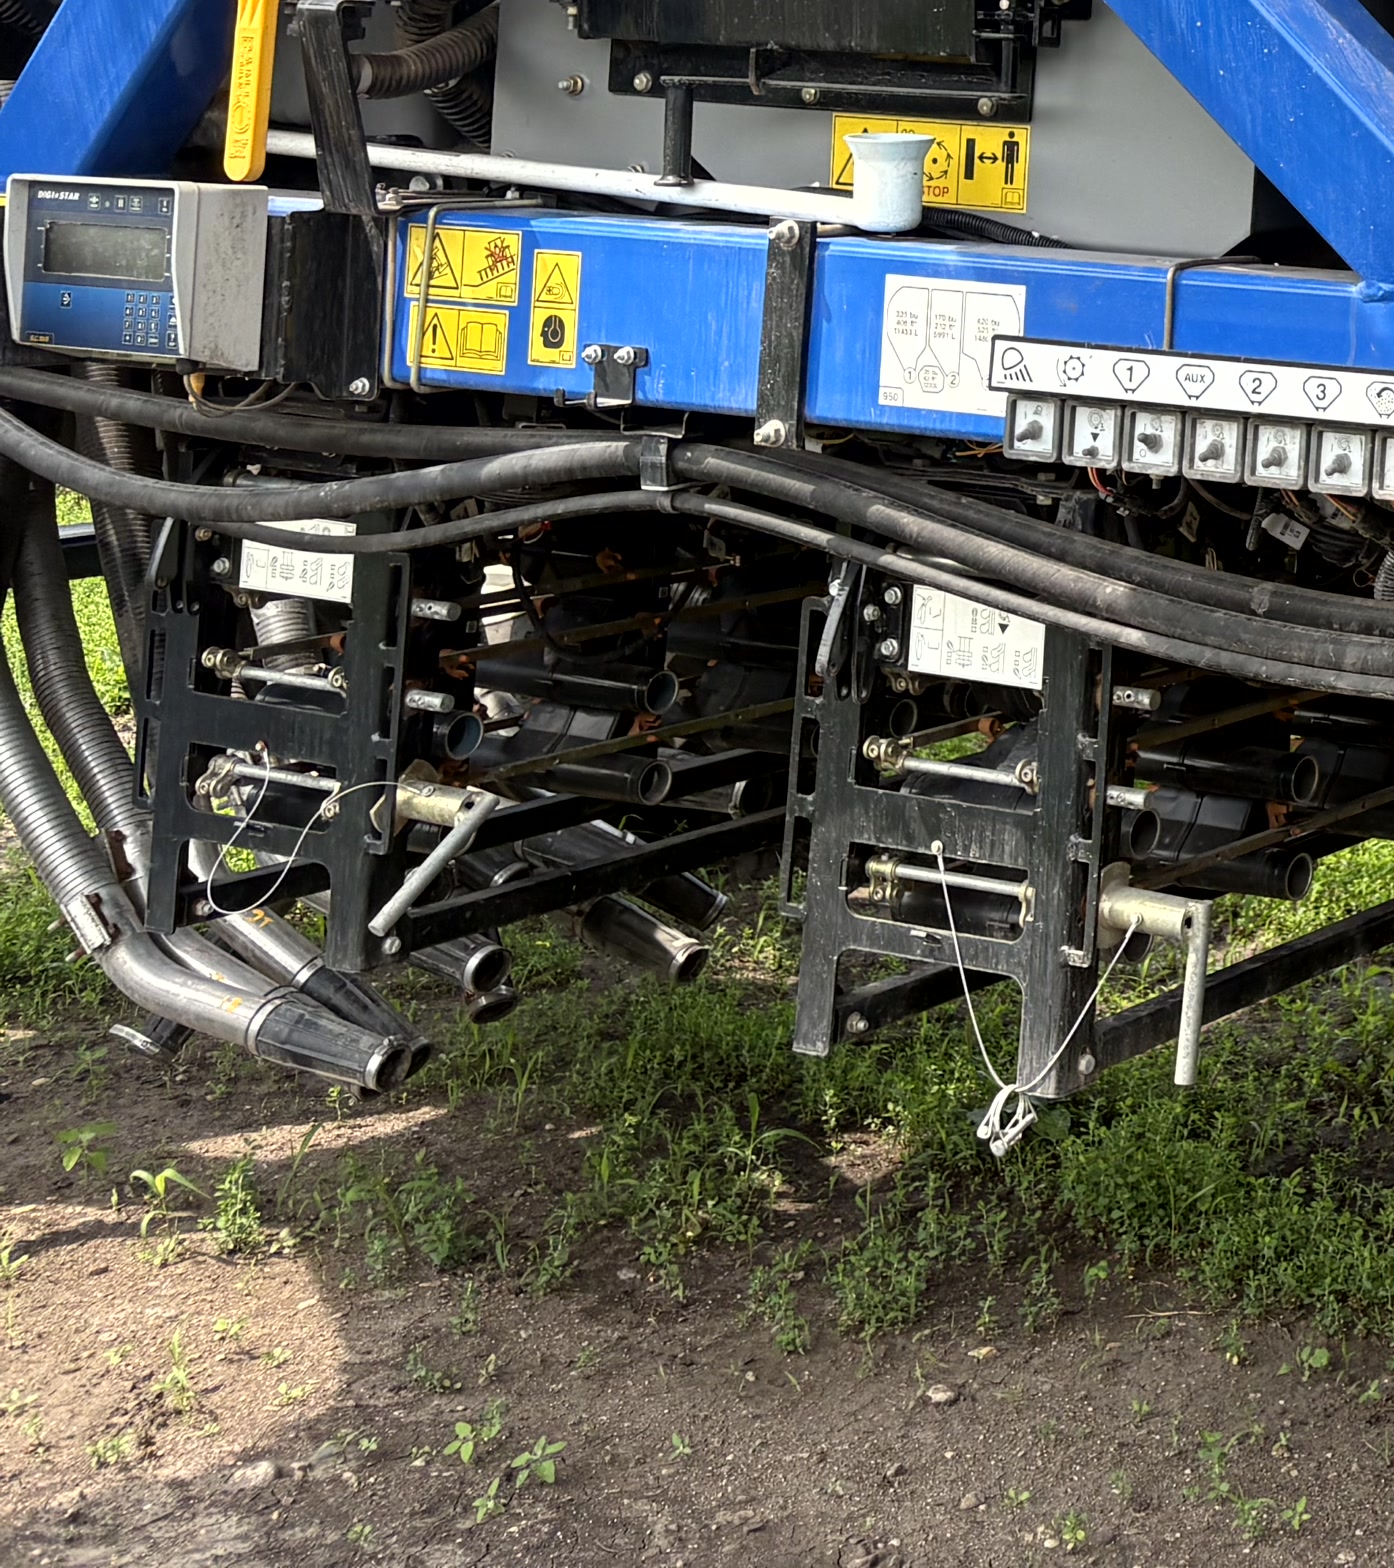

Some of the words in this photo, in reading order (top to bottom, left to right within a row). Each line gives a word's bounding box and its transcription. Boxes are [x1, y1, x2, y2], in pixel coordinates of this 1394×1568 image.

[950, 374, 956, 385] 2
[1125, 366, 1135, 383] 1
[1184, 372, 1206, 385] AUX
[1251, 377, 1263, 395] 2
[1315, 383, 1327, 401] 3
[883, 392, 899, 401] 950
